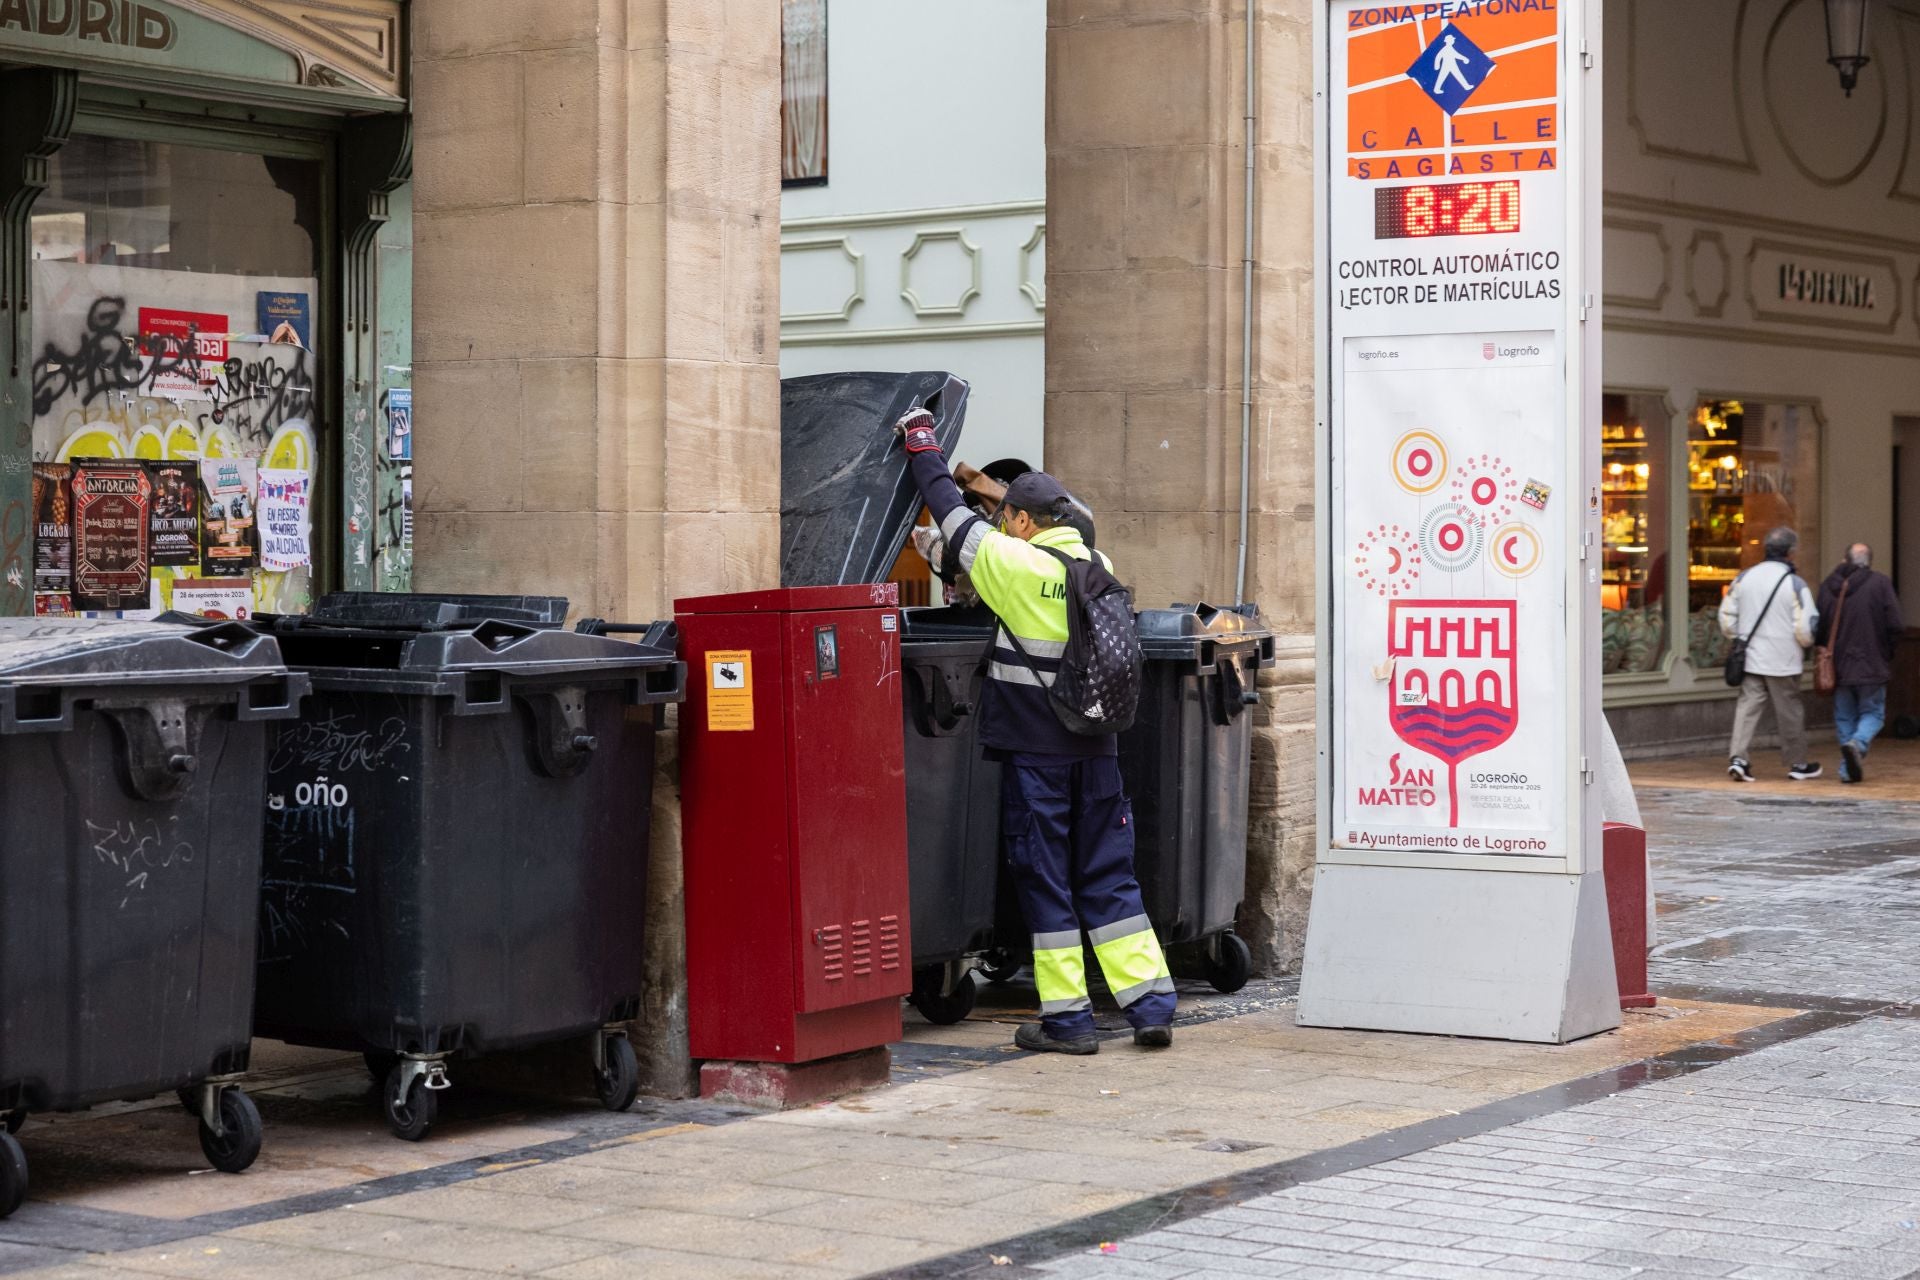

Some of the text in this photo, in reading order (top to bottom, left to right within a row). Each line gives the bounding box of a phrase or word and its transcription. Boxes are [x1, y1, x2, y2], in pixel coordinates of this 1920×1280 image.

[1349, 0, 1555, 27] ZONA PEATONAL
[1358, 150, 1554, 180] SAGASTA
[1406, 181, 1519, 236] 8:20
[1339, 248, 1560, 279] CONTROL AUTOMÁTICO
[1340, 277, 1561, 310] LECTOR DE MATRÍCULAS
[1358, 350, 1399, 361] logroño.es
[1498, 345, 1540, 358] Logroño
[87, 479, 138, 493] ANTORCHA
[267, 508, 300, 521] EN FIESTAS
[270, 523, 298, 537] MENORES
[266, 539, 276, 553] SIN
[276, 537, 307, 554] ALCOHOL
[1389, 753, 1434, 787] SAN
[1470, 772, 1528, 784] LOGROÑO
[1359, 787, 1437, 806] MATEO
[1360, 832, 1547, 852] Ayuntamiento de Logroño
